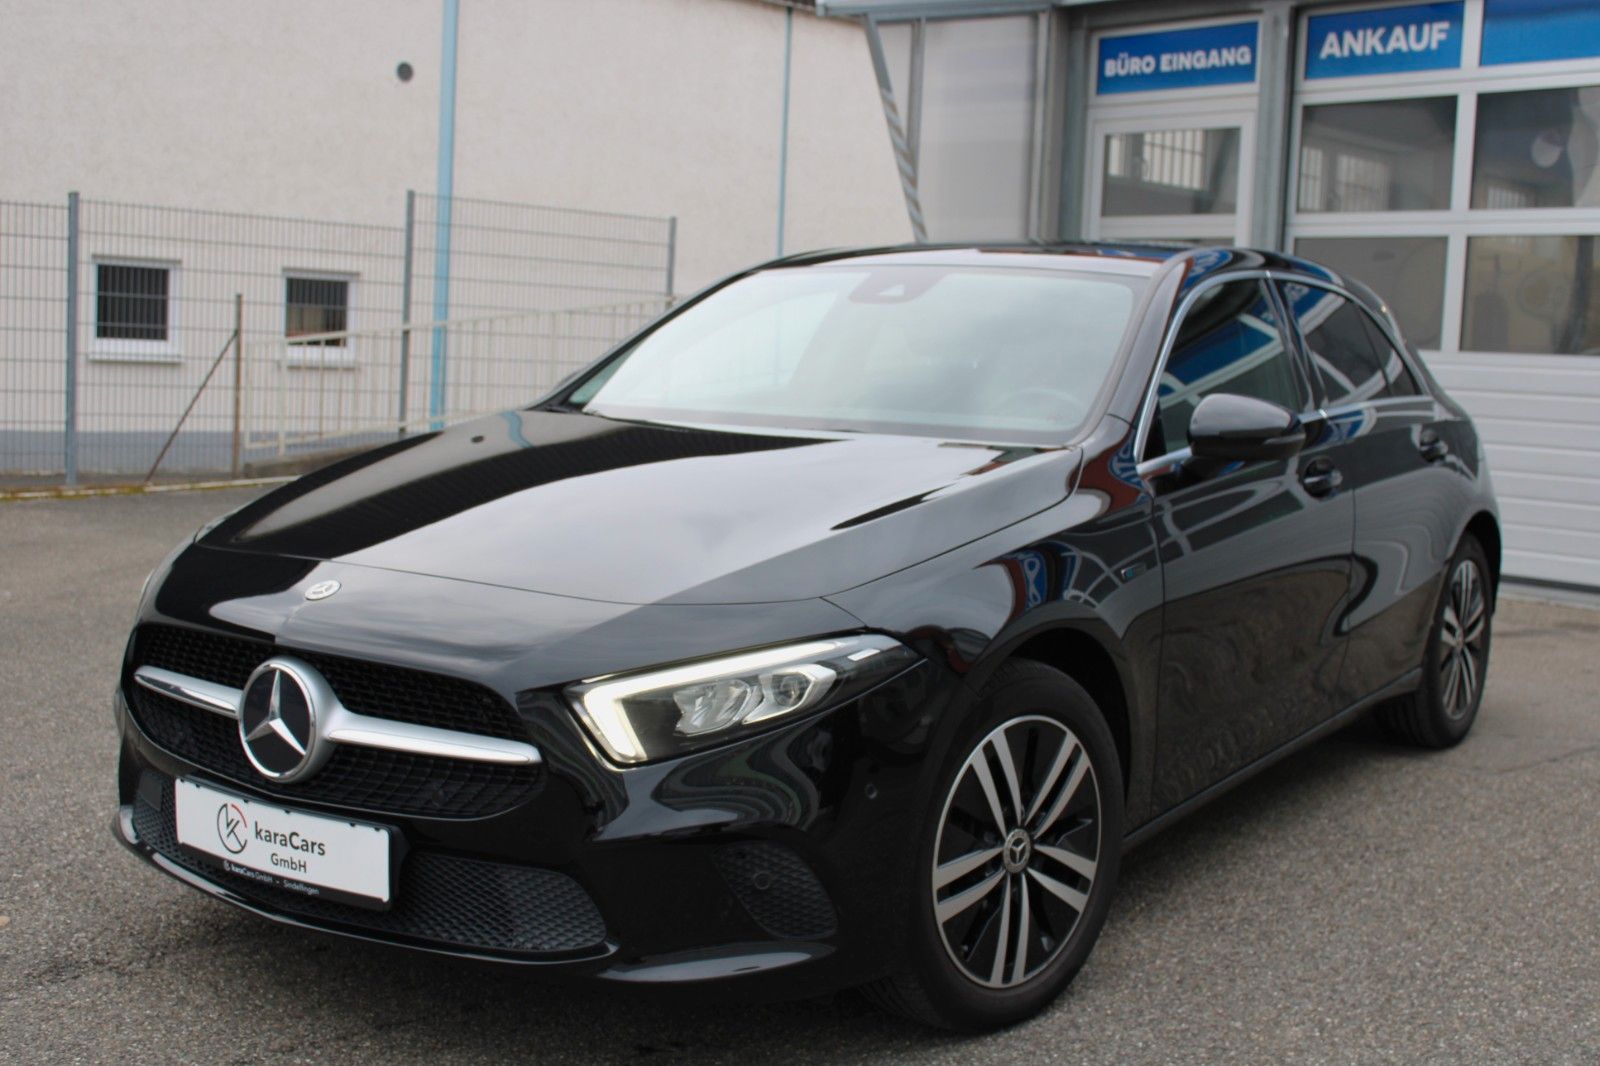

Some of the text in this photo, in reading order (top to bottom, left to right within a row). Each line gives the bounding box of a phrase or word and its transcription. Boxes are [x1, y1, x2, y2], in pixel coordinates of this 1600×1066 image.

[1319, 21, 1450, 60] ANKAUF
[1104, 46, 1251, 78] BÜRO EINGANG
[255, 821, 326, 856] karaCars
[270, 852, 307, 874] GmbH
